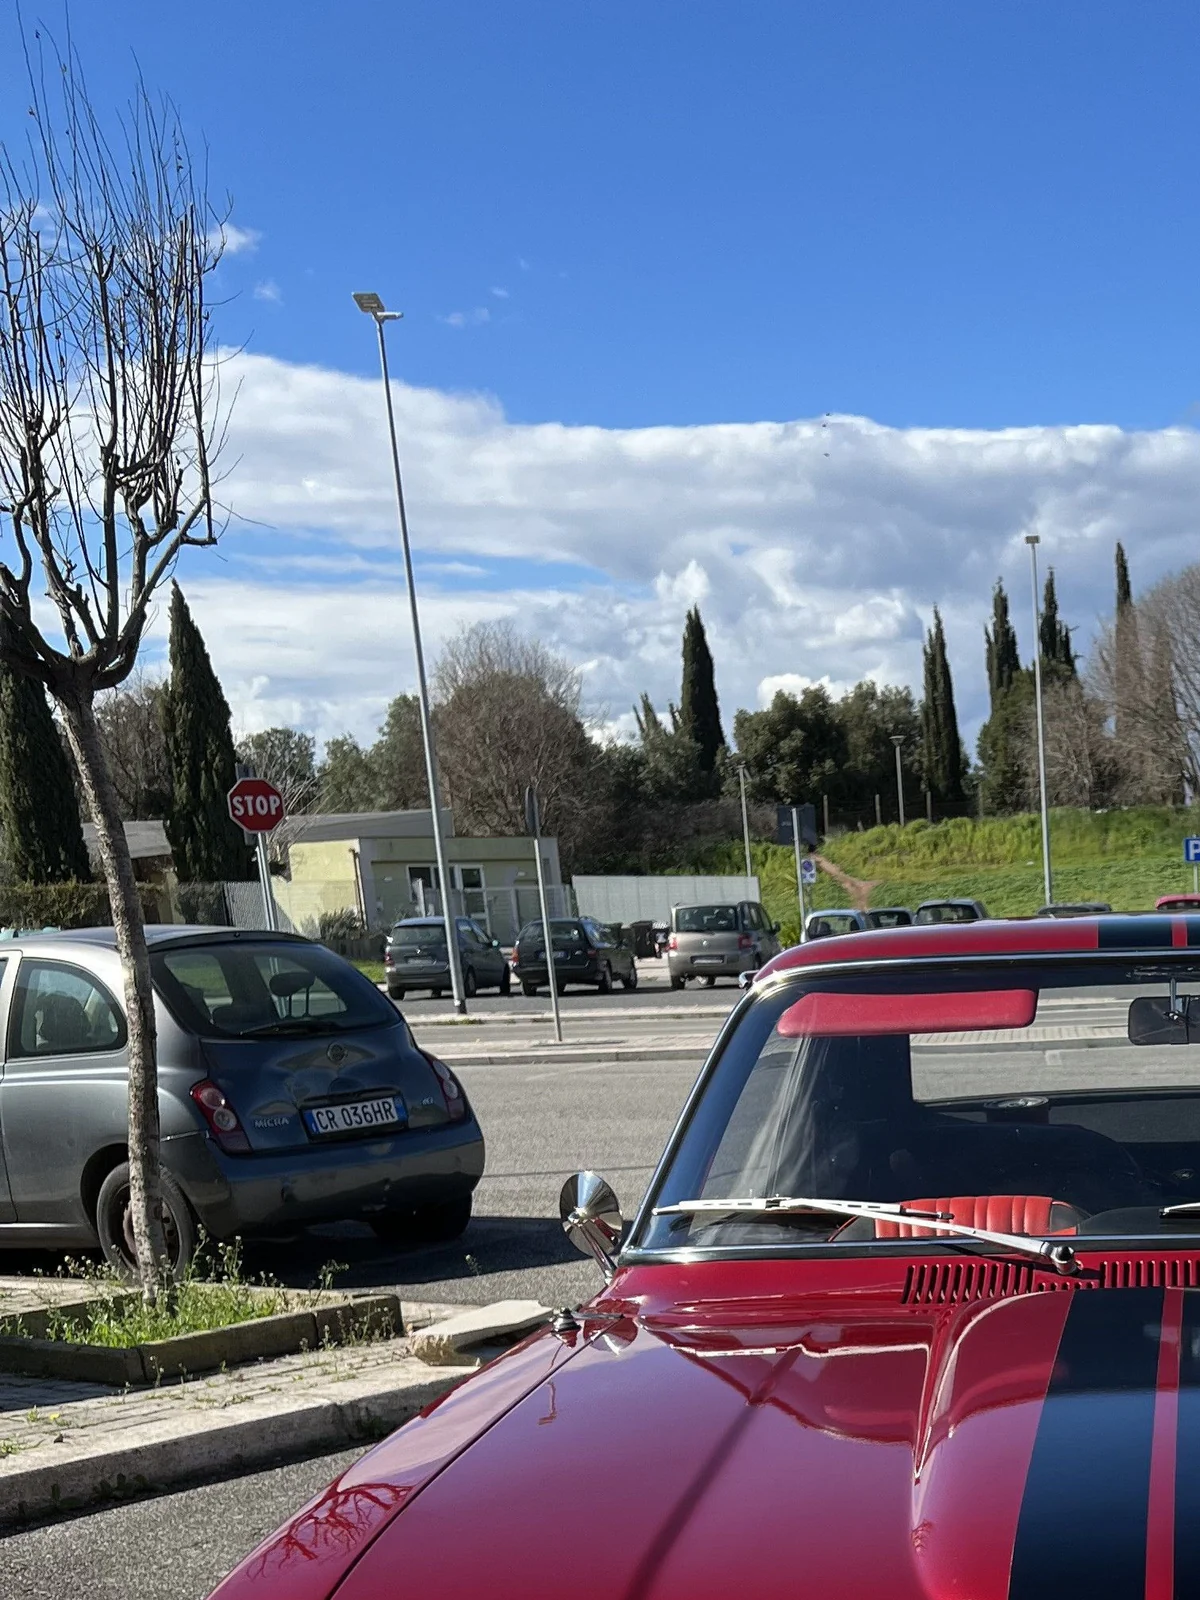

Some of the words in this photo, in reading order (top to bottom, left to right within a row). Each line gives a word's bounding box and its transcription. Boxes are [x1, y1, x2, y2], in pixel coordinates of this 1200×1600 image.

[232, 795, 280, 817] STOP
[315, 1110, 339, 1130] CR
[341, 1101, 395, 1127] 036HR
